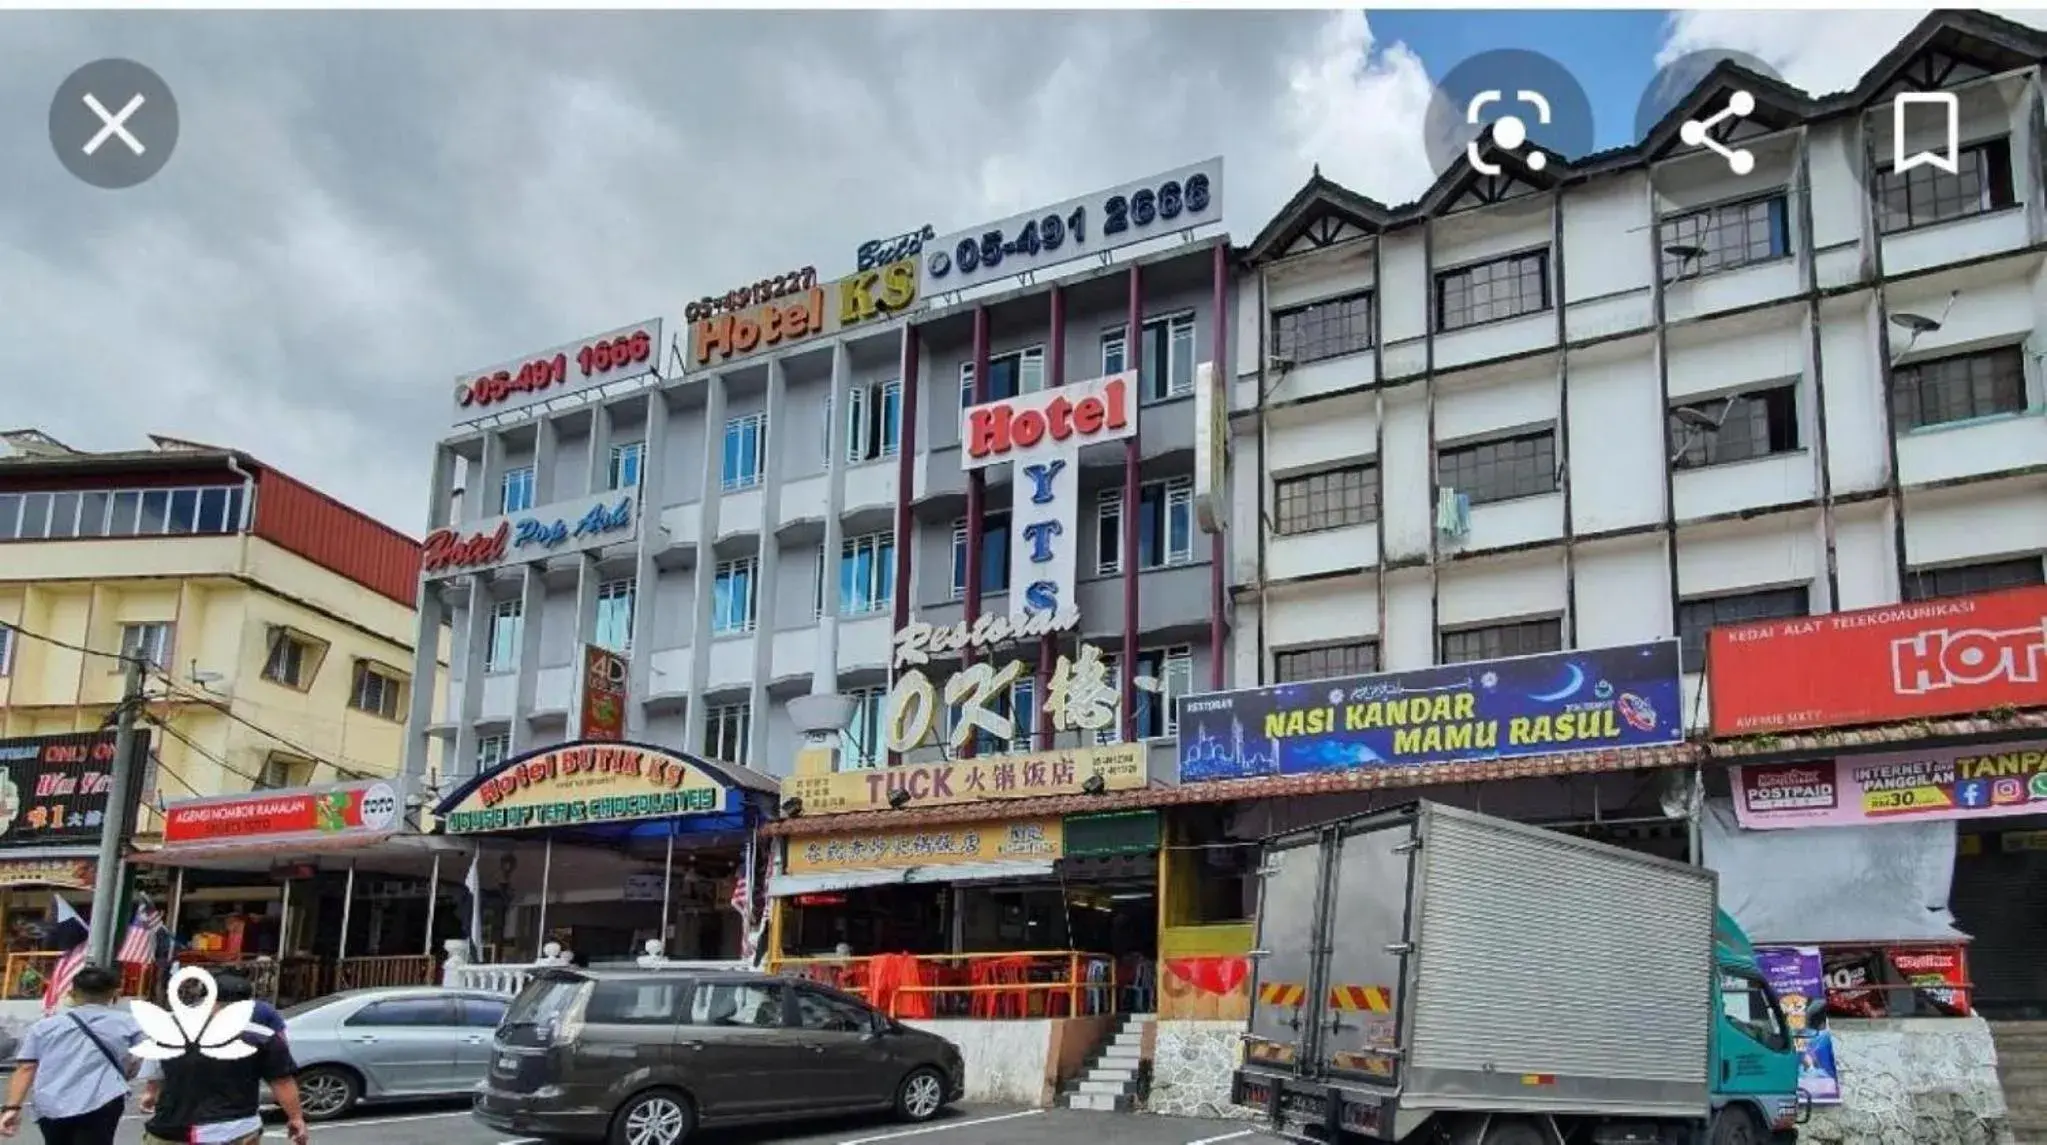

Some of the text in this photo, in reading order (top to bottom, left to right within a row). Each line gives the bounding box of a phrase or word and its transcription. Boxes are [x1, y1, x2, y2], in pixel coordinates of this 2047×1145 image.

[956, 173, 1211, 274] 05-491 2666
[697, 260, 915, 364] Hotel KS
[475, 330, 650, 405] 05-491 1666
[969, 379, 1126, 457] Hotel
[424, 520, 509, 571] Hotel
[894, 605, 1081, 669] Restoran
[1728, 600, 1976, 643] KEDAI ALAT TELEKOMUNIKASI
[590, 654, 626, 682] 4D
[1890, 616, 2047, 694] HOT
[887, 658, 1030, 752] OK
[1265, 692, 1475, 739] NASI KANDAR
[1393, 709, 1621, 756] MAMU RASUL
[478, 753, 557, 807] Hotel
[561, 747, 643, 778] BUTIK
[866, 767, 955, 804] TUCK
[1747, 784, 1833, 800] POSTPAID
[1854, 761, 1933, 781] INTERNET
[1862, 771, 1955, 792] PANGGILAN
